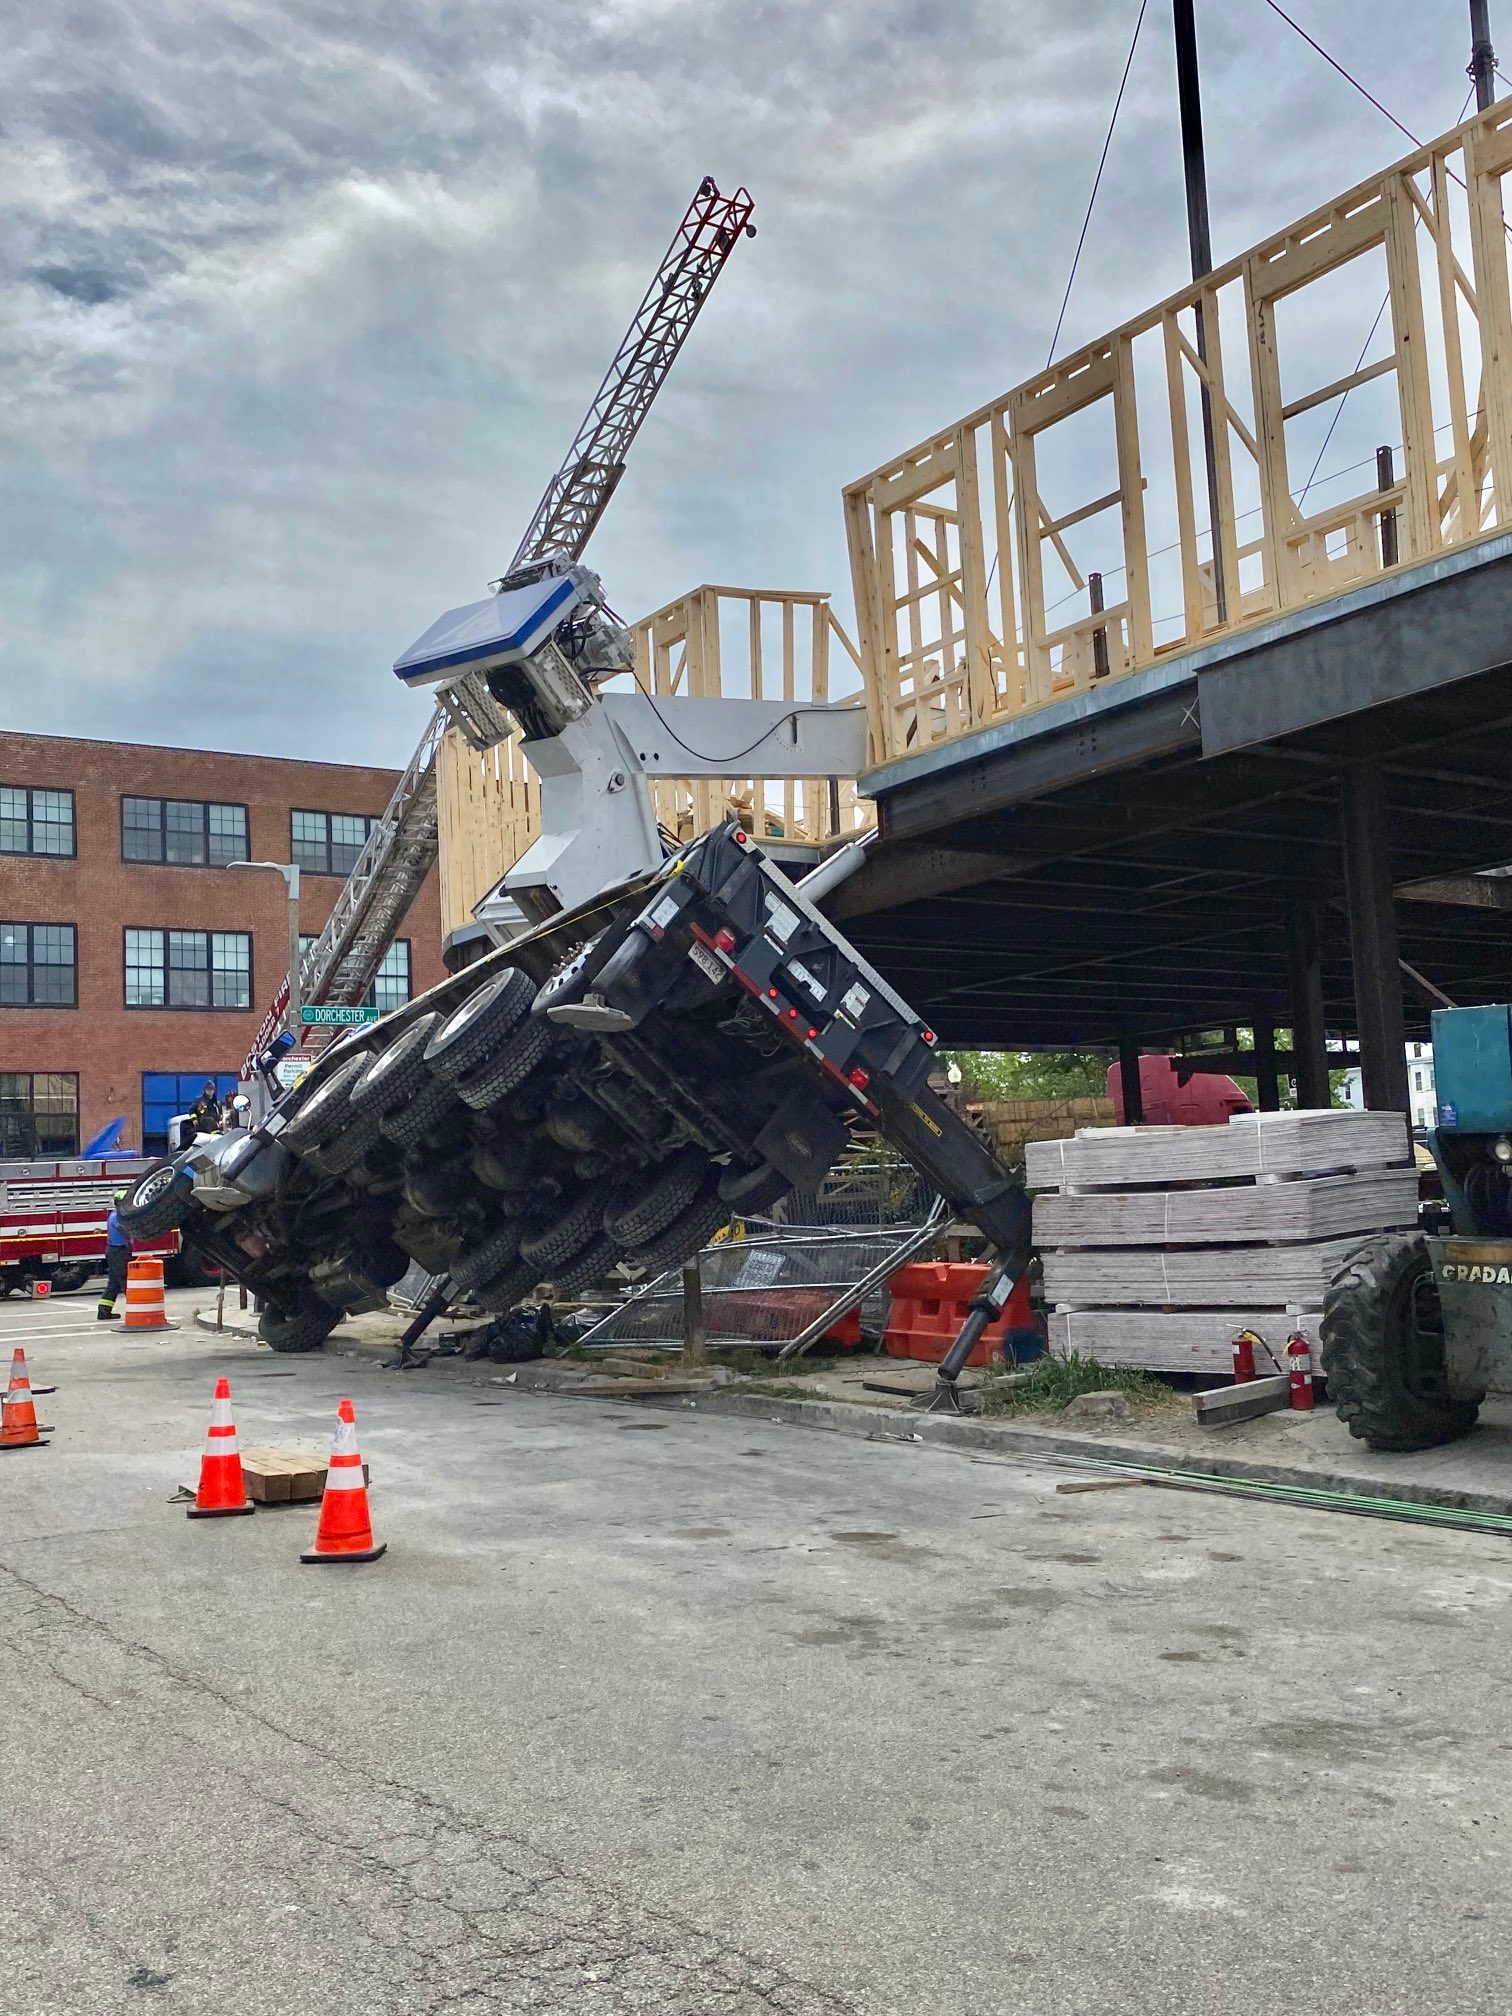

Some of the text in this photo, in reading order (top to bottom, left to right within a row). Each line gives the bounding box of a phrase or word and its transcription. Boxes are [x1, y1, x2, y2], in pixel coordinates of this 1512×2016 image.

[708, 961, 722, 980] 142
[315, 1008, 378, 1023] DORCHESTER AVE
[1442, 1264, 1512, 1285] GRADA
